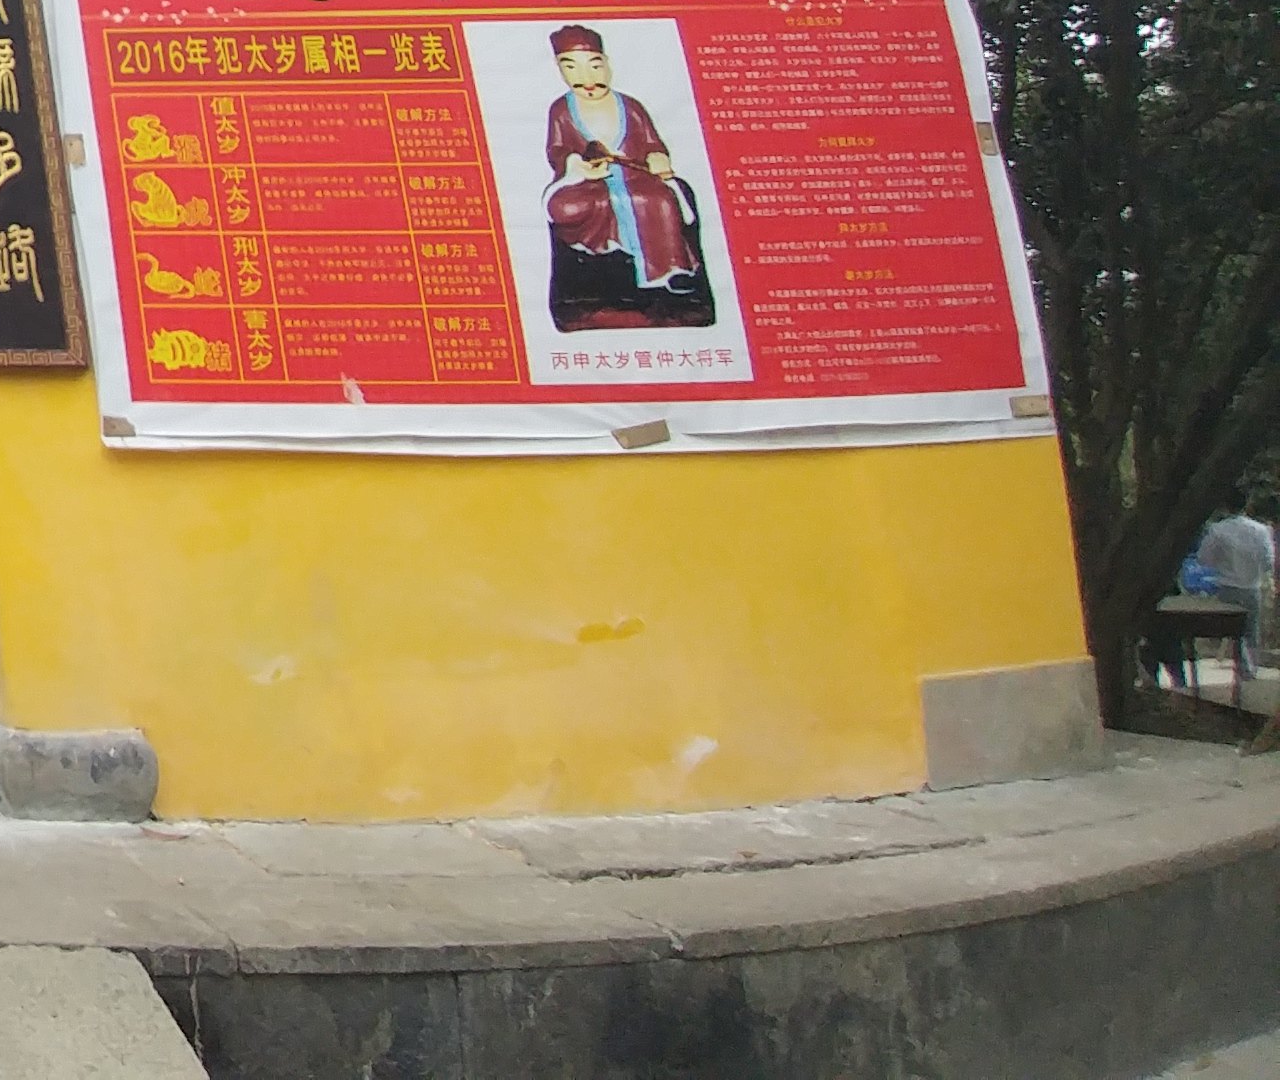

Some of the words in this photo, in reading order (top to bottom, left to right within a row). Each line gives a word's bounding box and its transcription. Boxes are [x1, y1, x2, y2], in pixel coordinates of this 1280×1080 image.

[117, 32, 452, 76] 2016年犯太岁属相一览表
[210, 96, 241, 154] 值太岁
[221, 166, 251, 224] 冲太岁
[232, 236, 263, 297] 刑太岁
[243, 309, 273, 371] 害太岁
[551, 348, 735, 371] 丙申太岁管仲大将军
